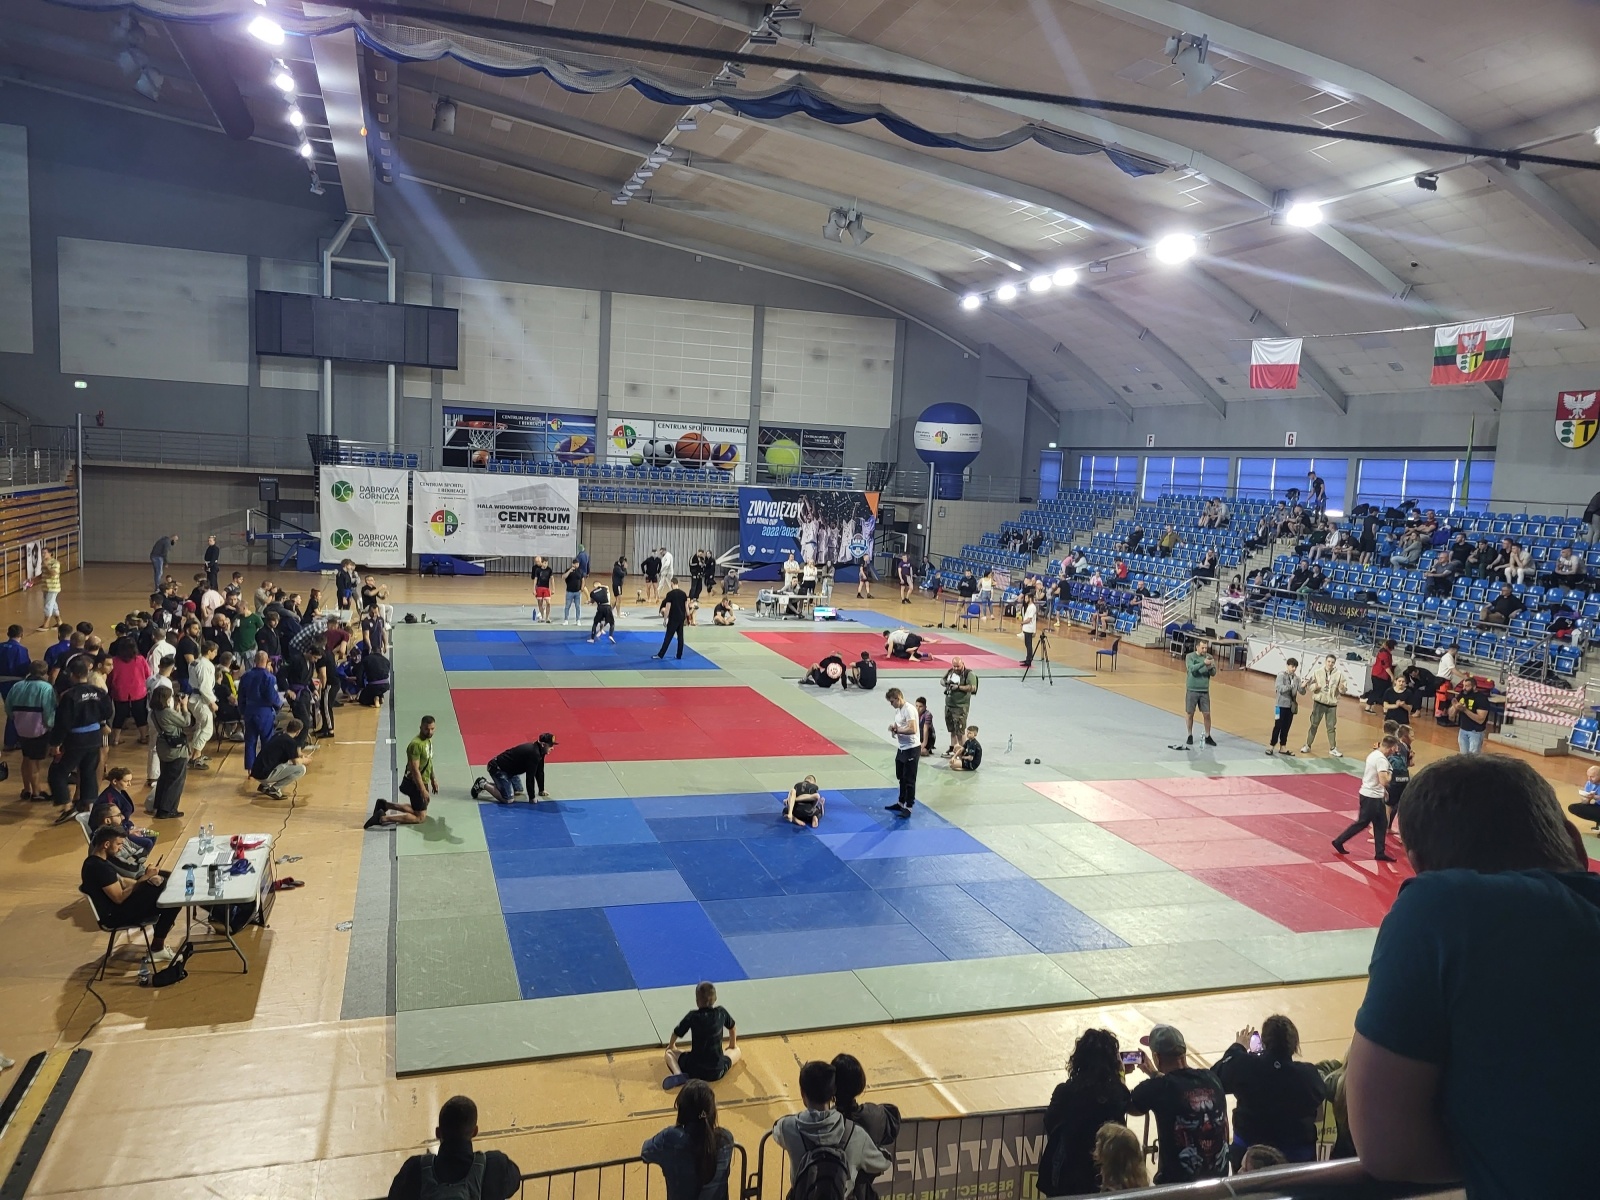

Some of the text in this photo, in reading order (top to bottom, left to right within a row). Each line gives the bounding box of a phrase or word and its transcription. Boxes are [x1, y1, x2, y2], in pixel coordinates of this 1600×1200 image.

[657, 422, 687, 430] CENTRUM
[1148, 435, 1153, 446] F
[1288, 433, 1294, 445] G
[359, 486, 400, 494] DĄBROWA
[359, 492, 400, 500] GÓRNICZA
[748, 500, 804, 520] ZWYCIĘZCY
[498, 511, 570, 524] CENTRUM
[762, 526, 799, 537] 2022/2023
[358, 540, 398, 548] GÓRNICZA
